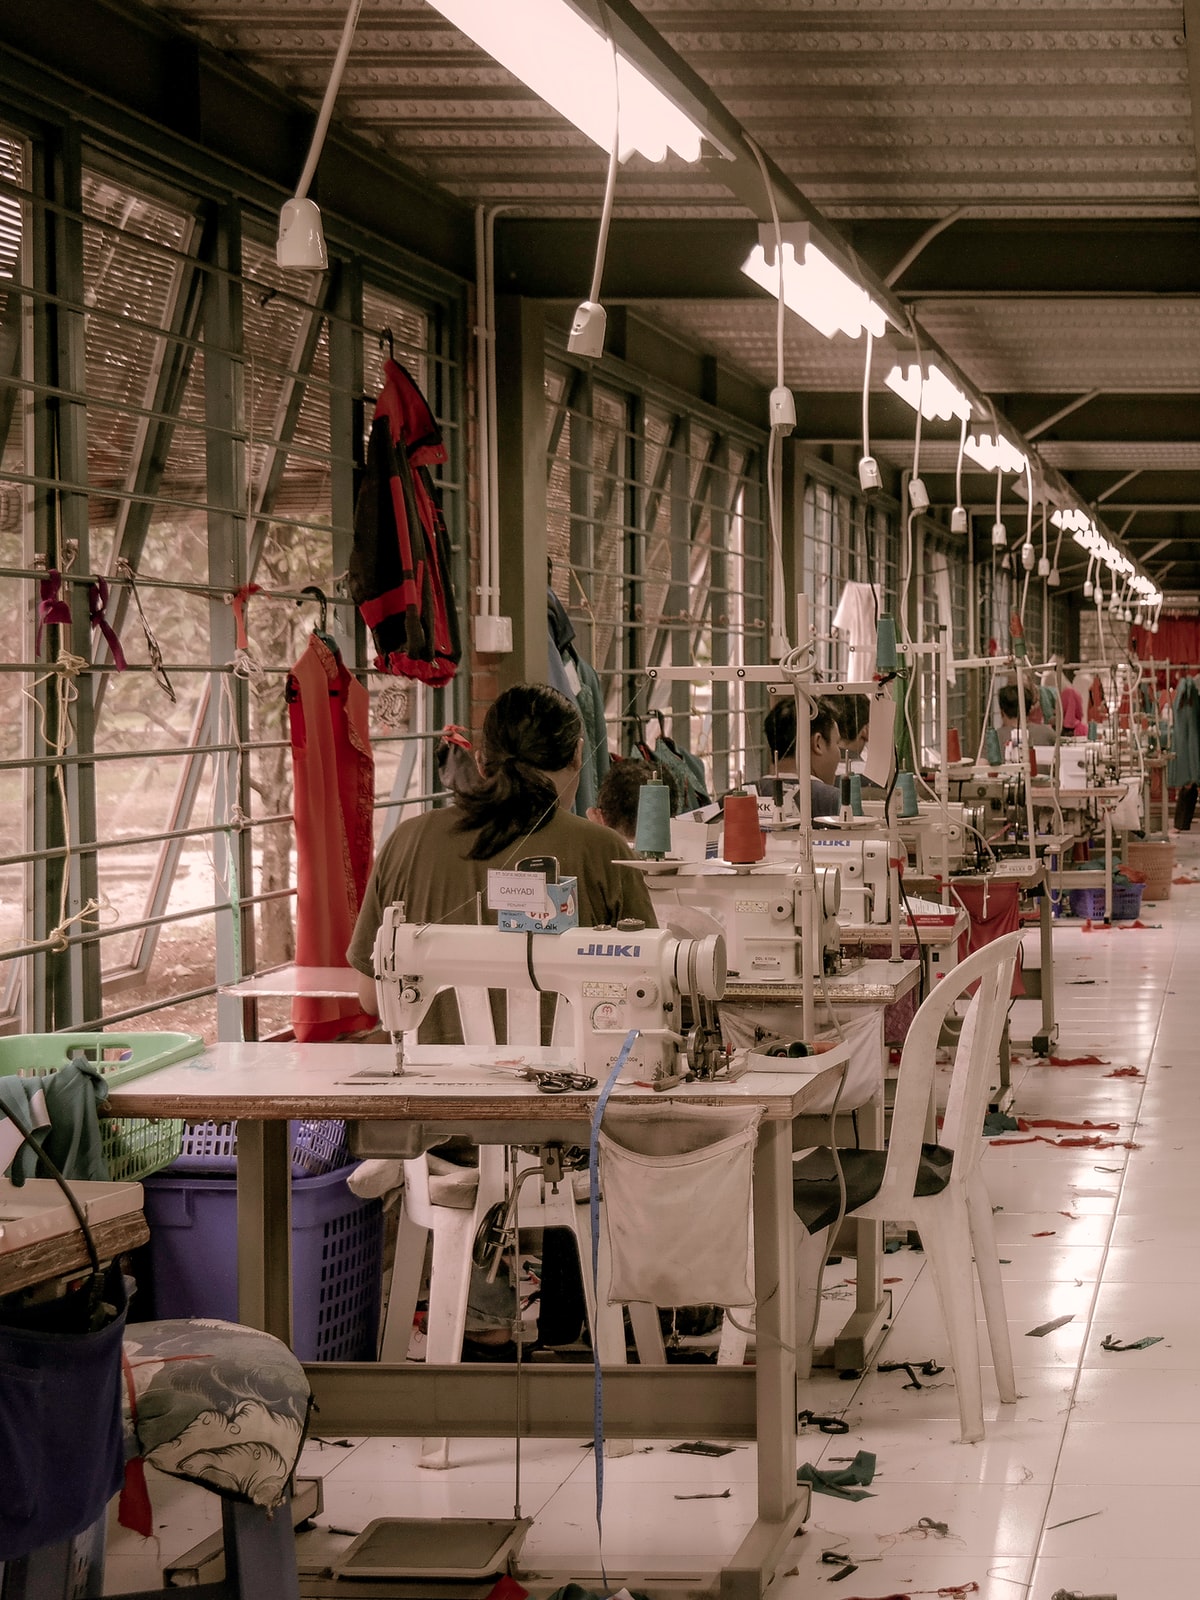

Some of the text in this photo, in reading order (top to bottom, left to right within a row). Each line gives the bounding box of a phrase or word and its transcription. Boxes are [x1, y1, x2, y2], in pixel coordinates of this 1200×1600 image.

[757, 803, 771, 811] KK
[500, 886, 535, 896] CAHYADI
[577, 943, 641, 958] JUKI
